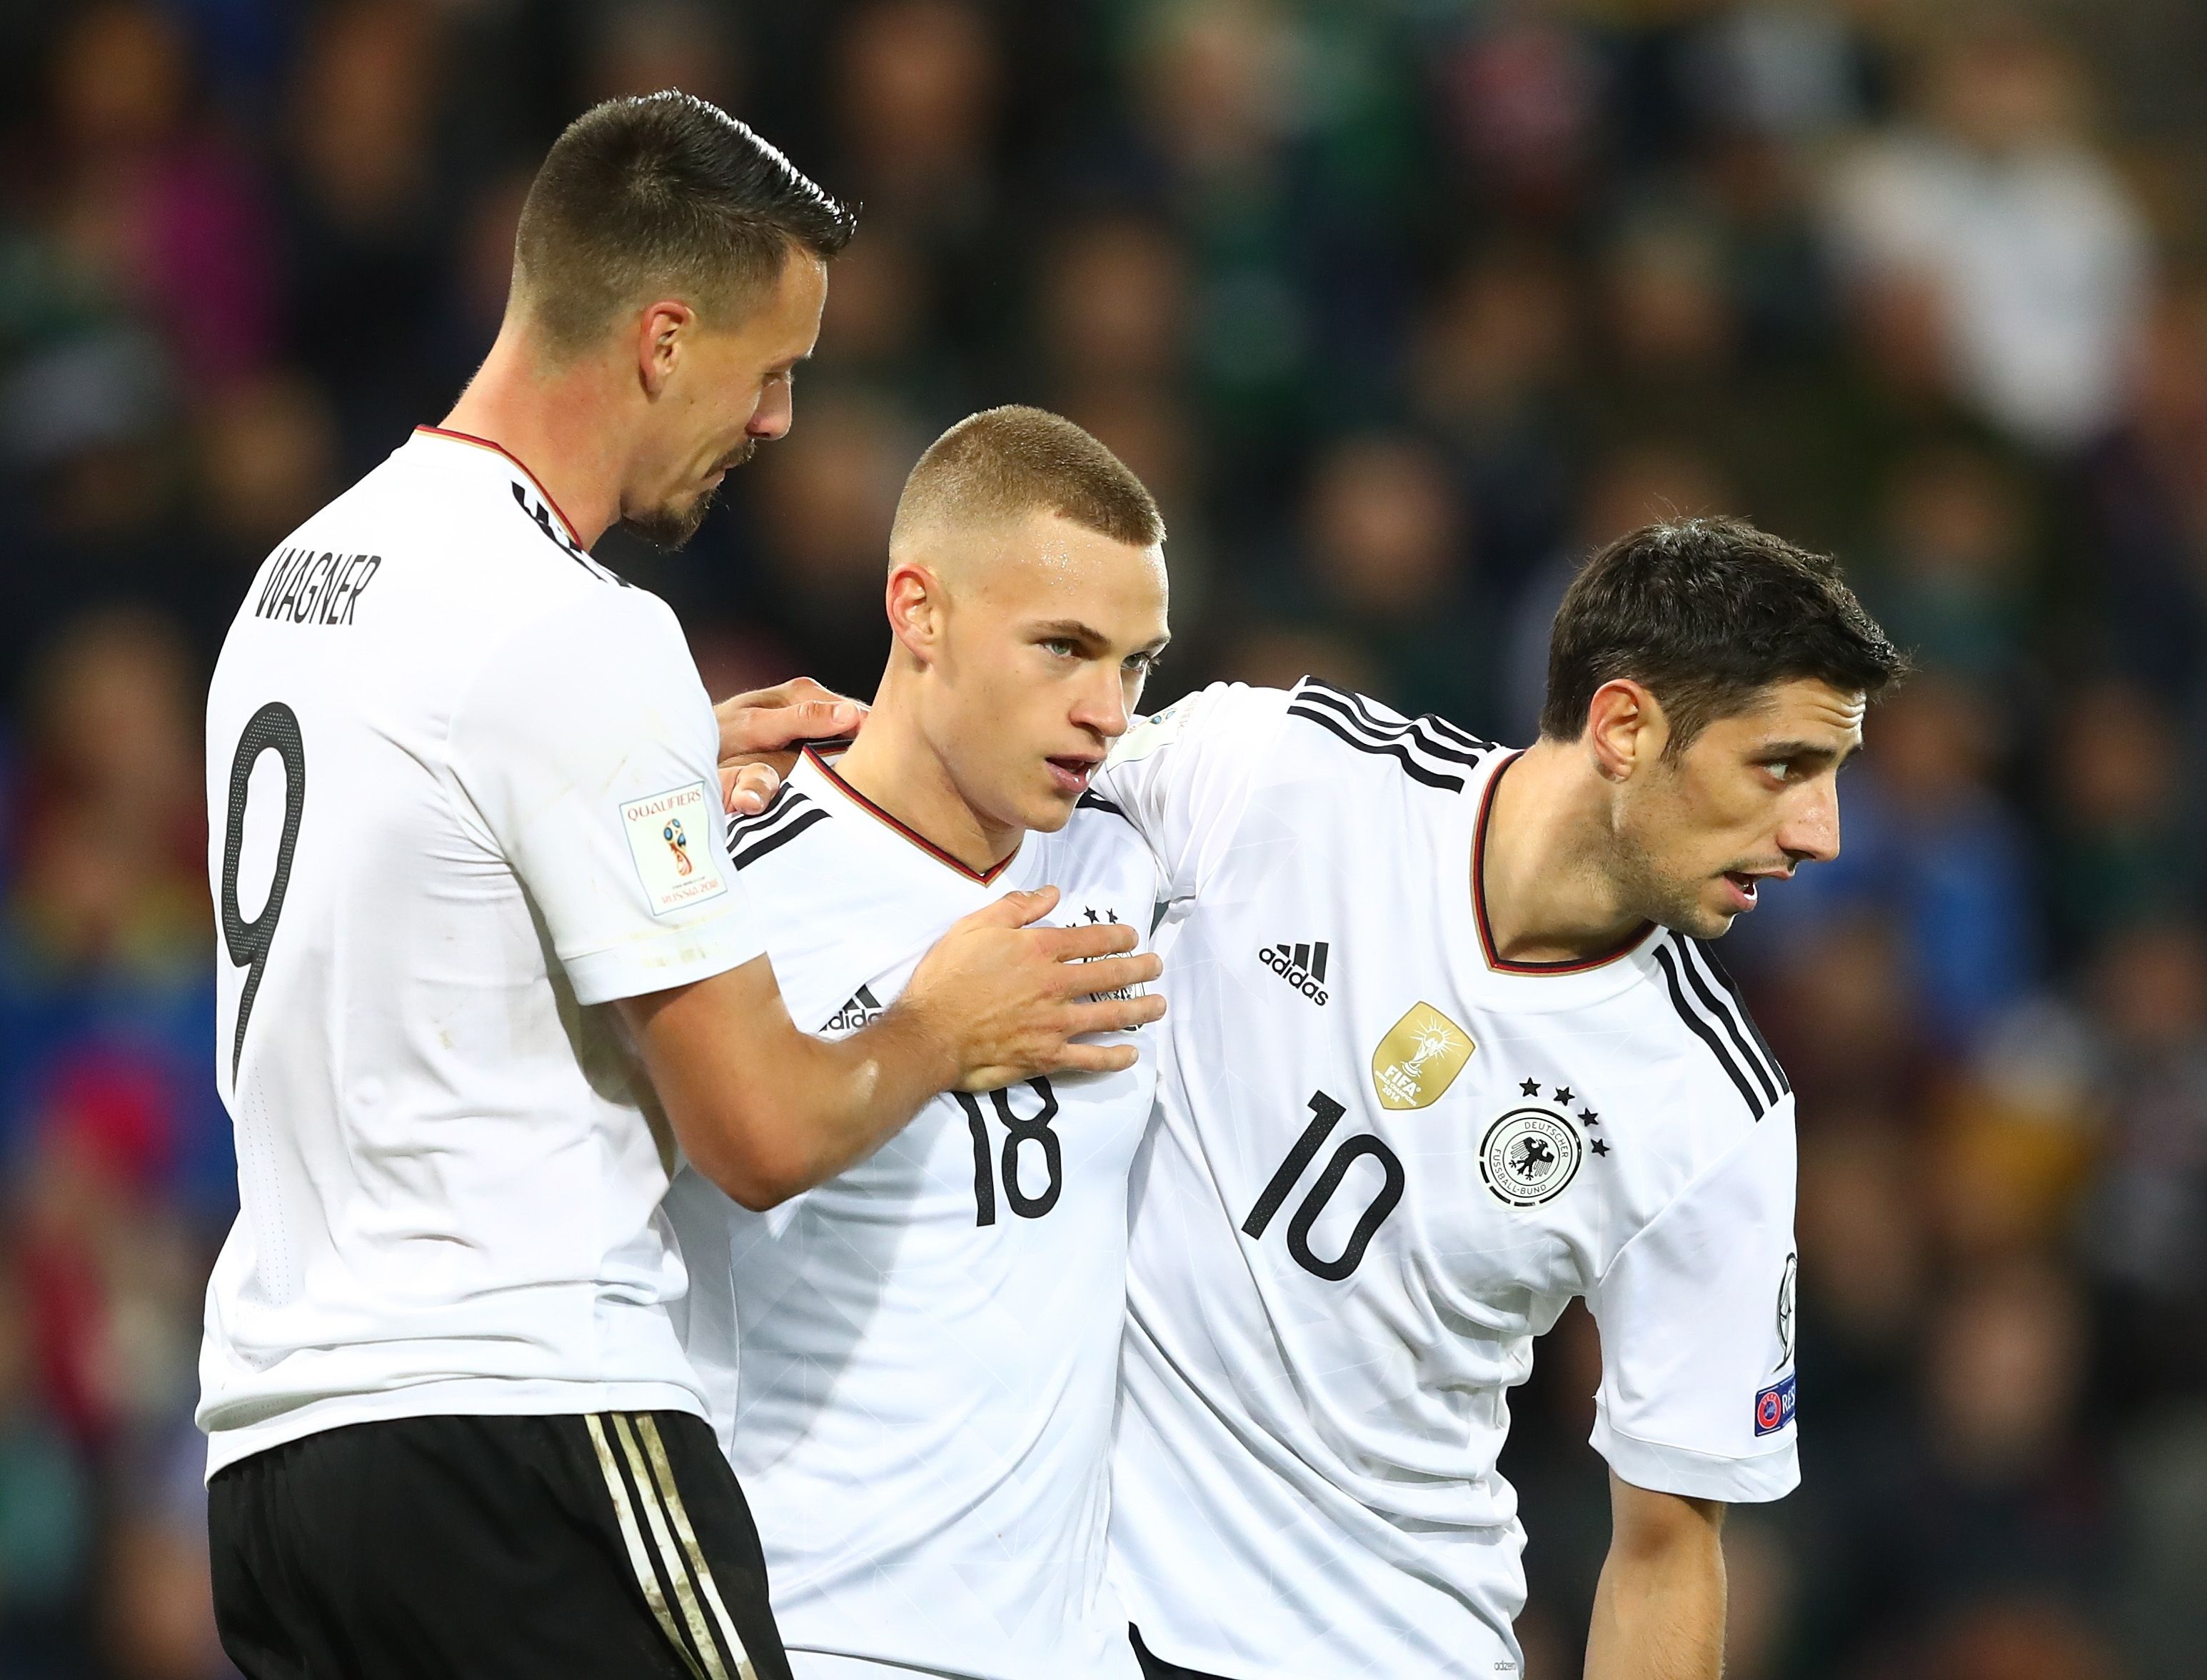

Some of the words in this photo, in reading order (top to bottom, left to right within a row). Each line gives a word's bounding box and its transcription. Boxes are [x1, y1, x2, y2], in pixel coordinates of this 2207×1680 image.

[255, 548, 381, 625] WAGNER
[628, 789, 701, 821] QUALIFIERS
[221, 701, 306, 1100] 9
[1259, 947, 1329, 1006] adidas
[1382, 1084, 1400, 1102] 2014
[1384, 1065, 1417, 1097] FIFA
[952, 1075, 1062, 1227] 18
[1524, 1121, 1569, 1158] DEUTSCHER
[1241, 1090, 1405, 1282] 10
[1493, 1149, 1547, 1194] FUSSBALL-BUND
